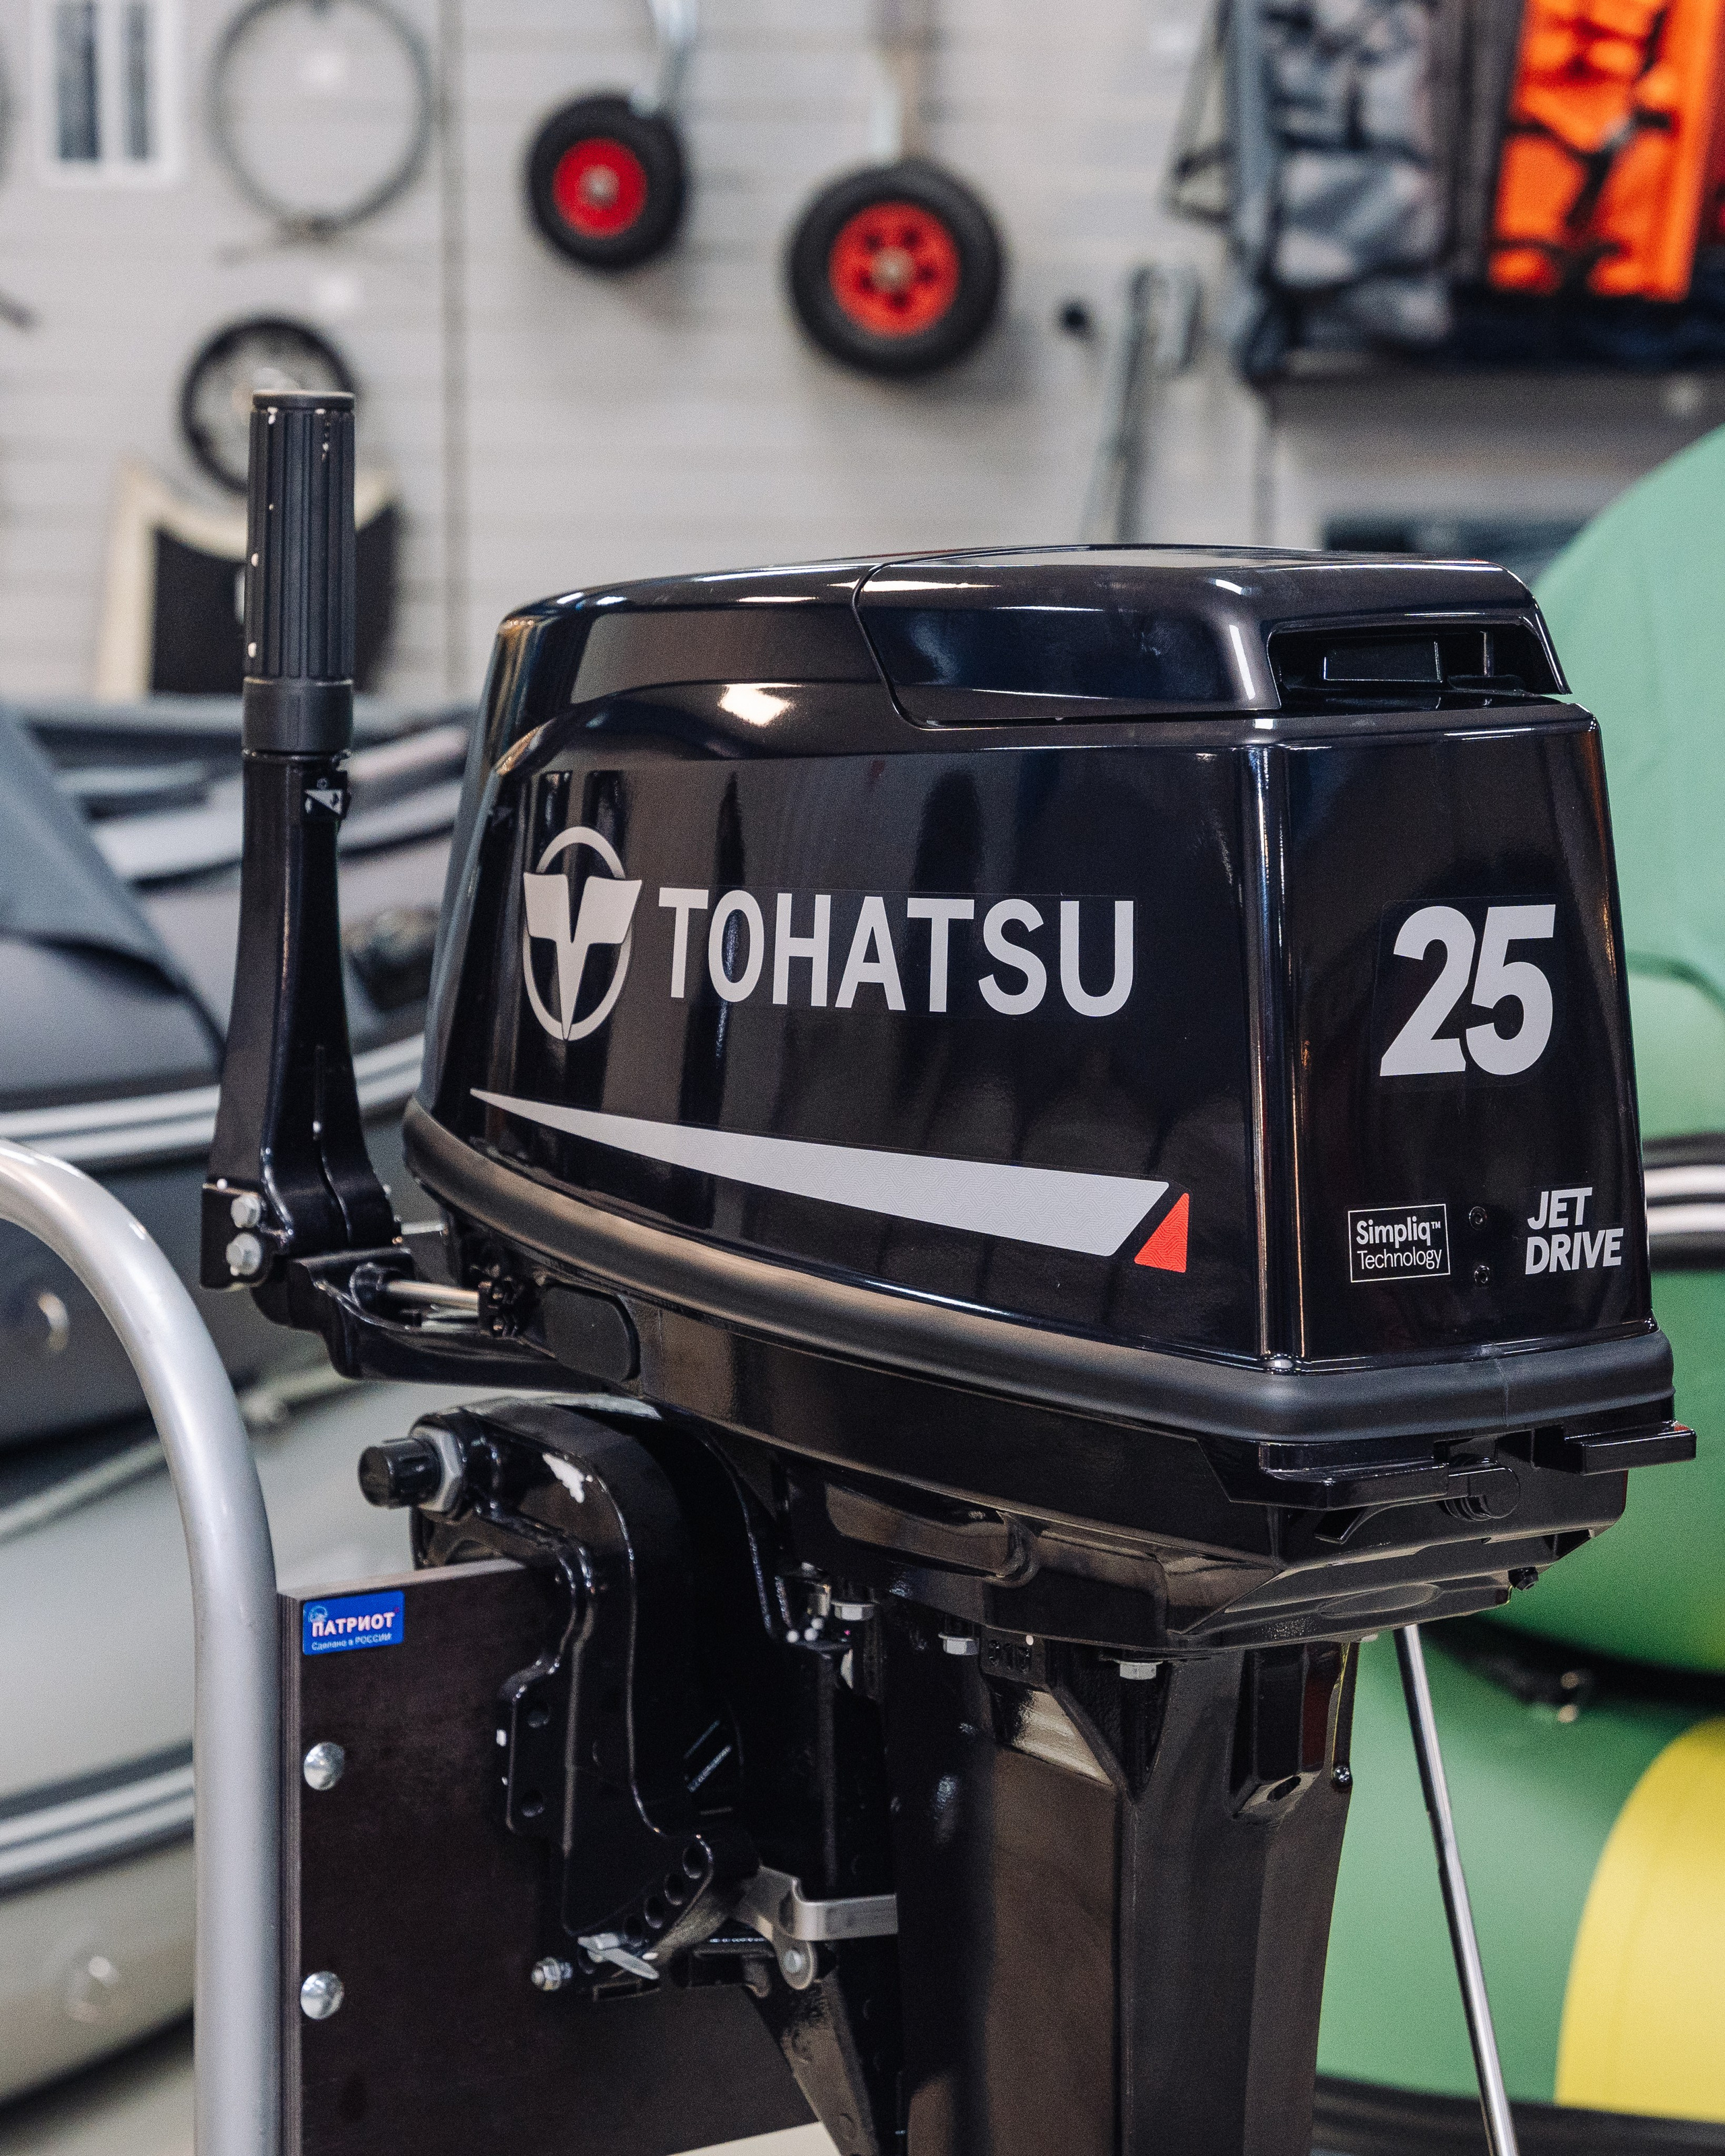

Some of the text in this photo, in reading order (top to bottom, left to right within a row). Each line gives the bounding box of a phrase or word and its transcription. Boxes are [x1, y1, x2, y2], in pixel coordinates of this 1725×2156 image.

[658, 887, 1134, 1017] TOHATSU
[1379, 904, 1556, 1077] 25
[1527, 1186, 1593, 1230] JET
[1356, 1246, 1442, 1270] Technology
[1525, 1228, 1624, 1275] DRIVE
[311, 1611, 396, 1637] ПАТРИОТ
[355, 1632, 392, 1645] РОССИИ
